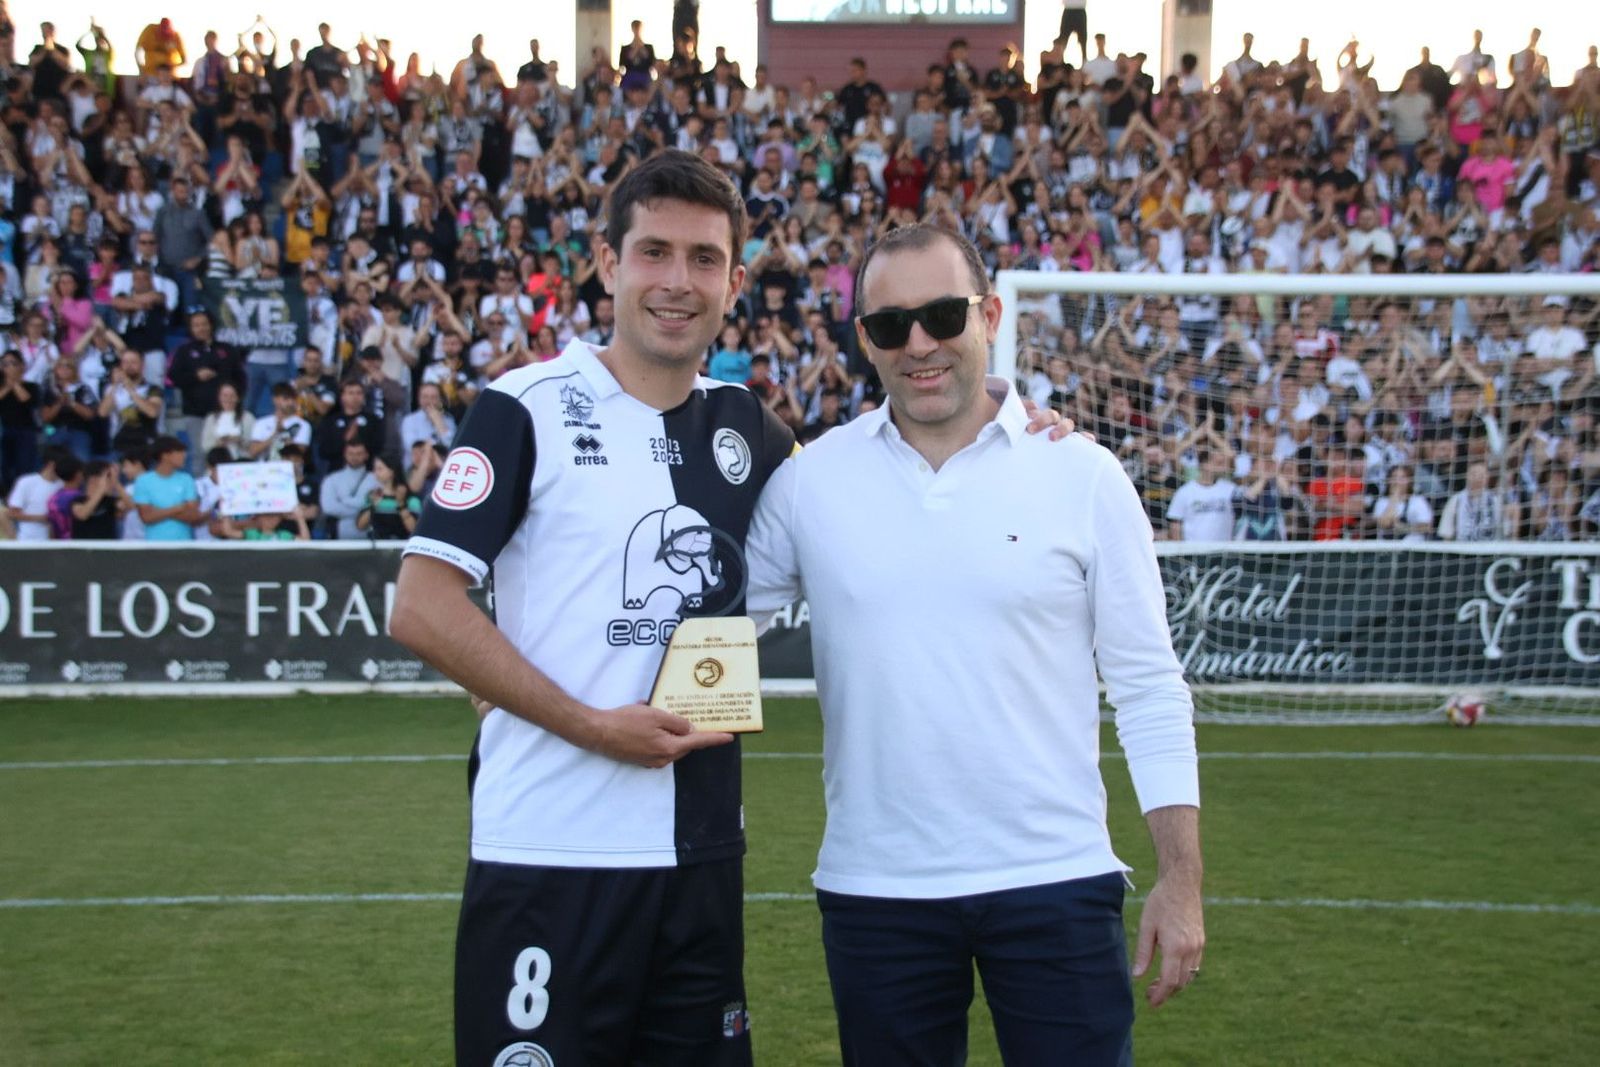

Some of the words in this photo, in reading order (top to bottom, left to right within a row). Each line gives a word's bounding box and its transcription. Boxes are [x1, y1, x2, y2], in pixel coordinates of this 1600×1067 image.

[574, 455, 609, 466] errea
[649, 438, 681, 453] 2013
[653, 451, 684, 465] 2023
[0, 582, 58, 638] E
[87, 581, 215, 639] LOS
[1166, 564, 1301, 623] Hotel
[506, 946, 552, 1031] 8
